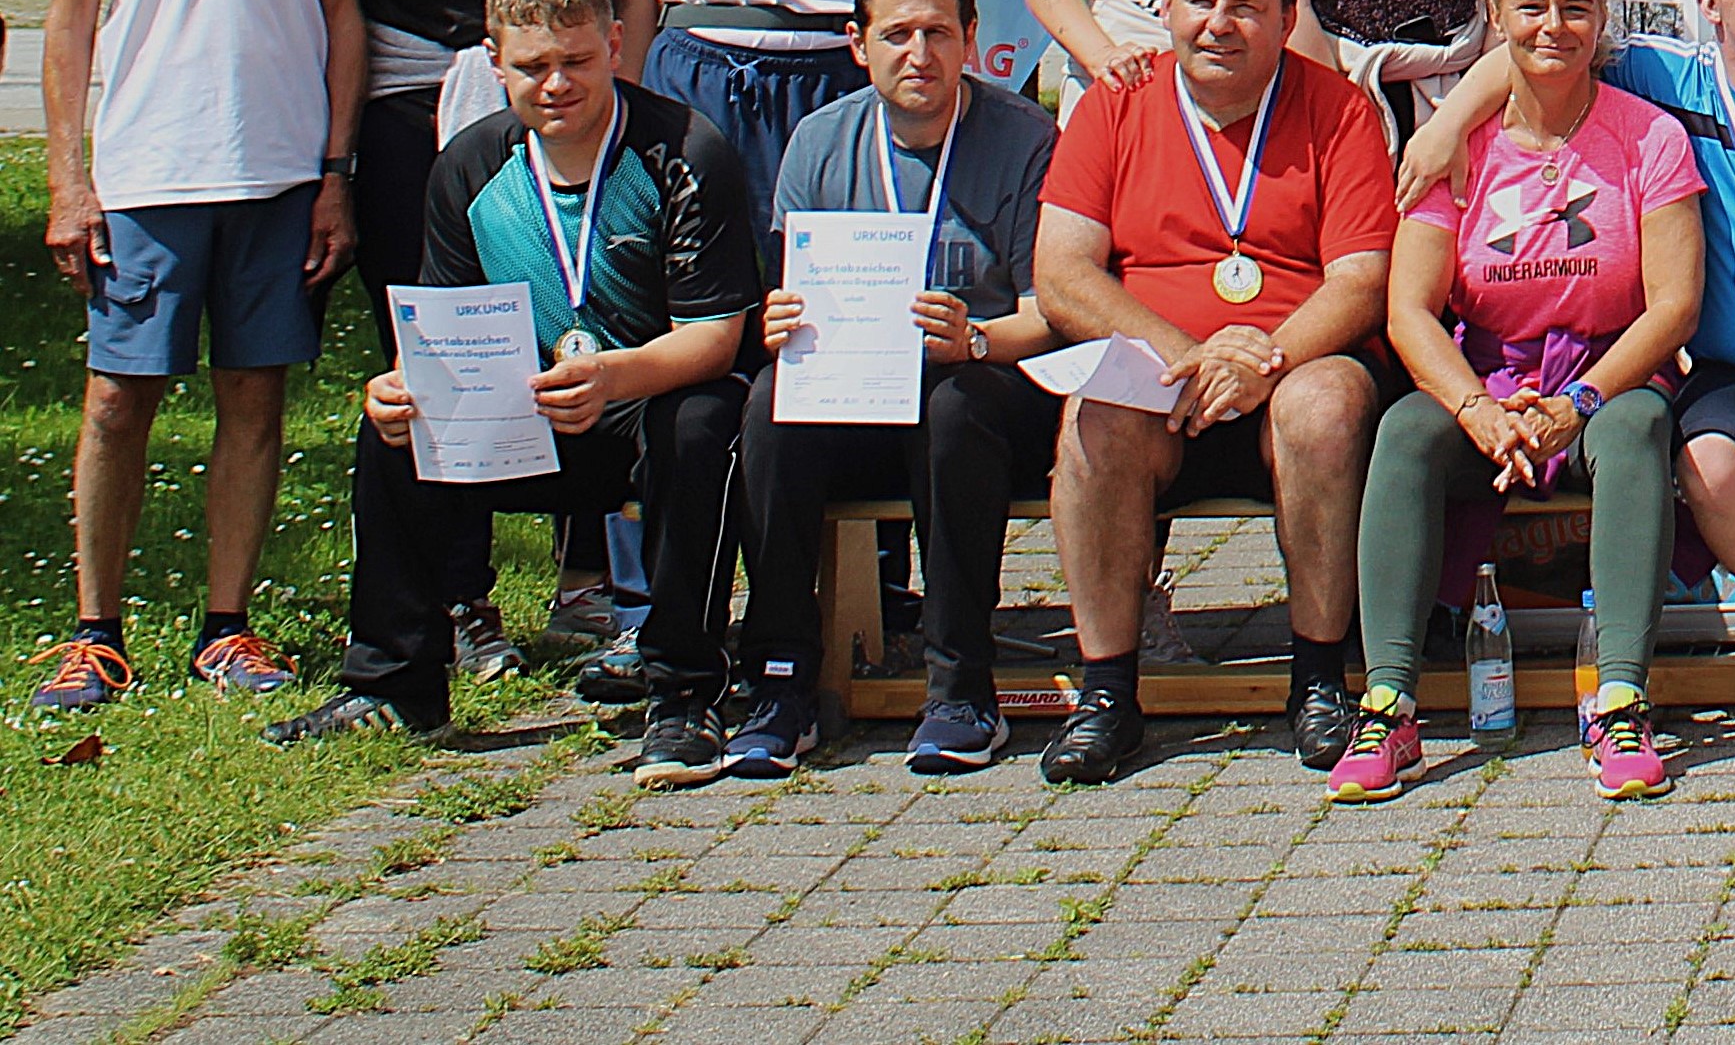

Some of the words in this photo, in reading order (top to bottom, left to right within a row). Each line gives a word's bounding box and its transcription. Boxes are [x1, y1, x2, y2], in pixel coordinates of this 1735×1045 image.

[853, 230, 914, 242] URKUNDE
[808, 263, 901, 275] Sportabzeichen
[1483, 261, 1533, 283] UNDER
[1534, 257, 1598, 279] ARMOUR
[456, 300, 520, 317] URKUNDE
[418, 334, 511, 346] Sportabzeichen
